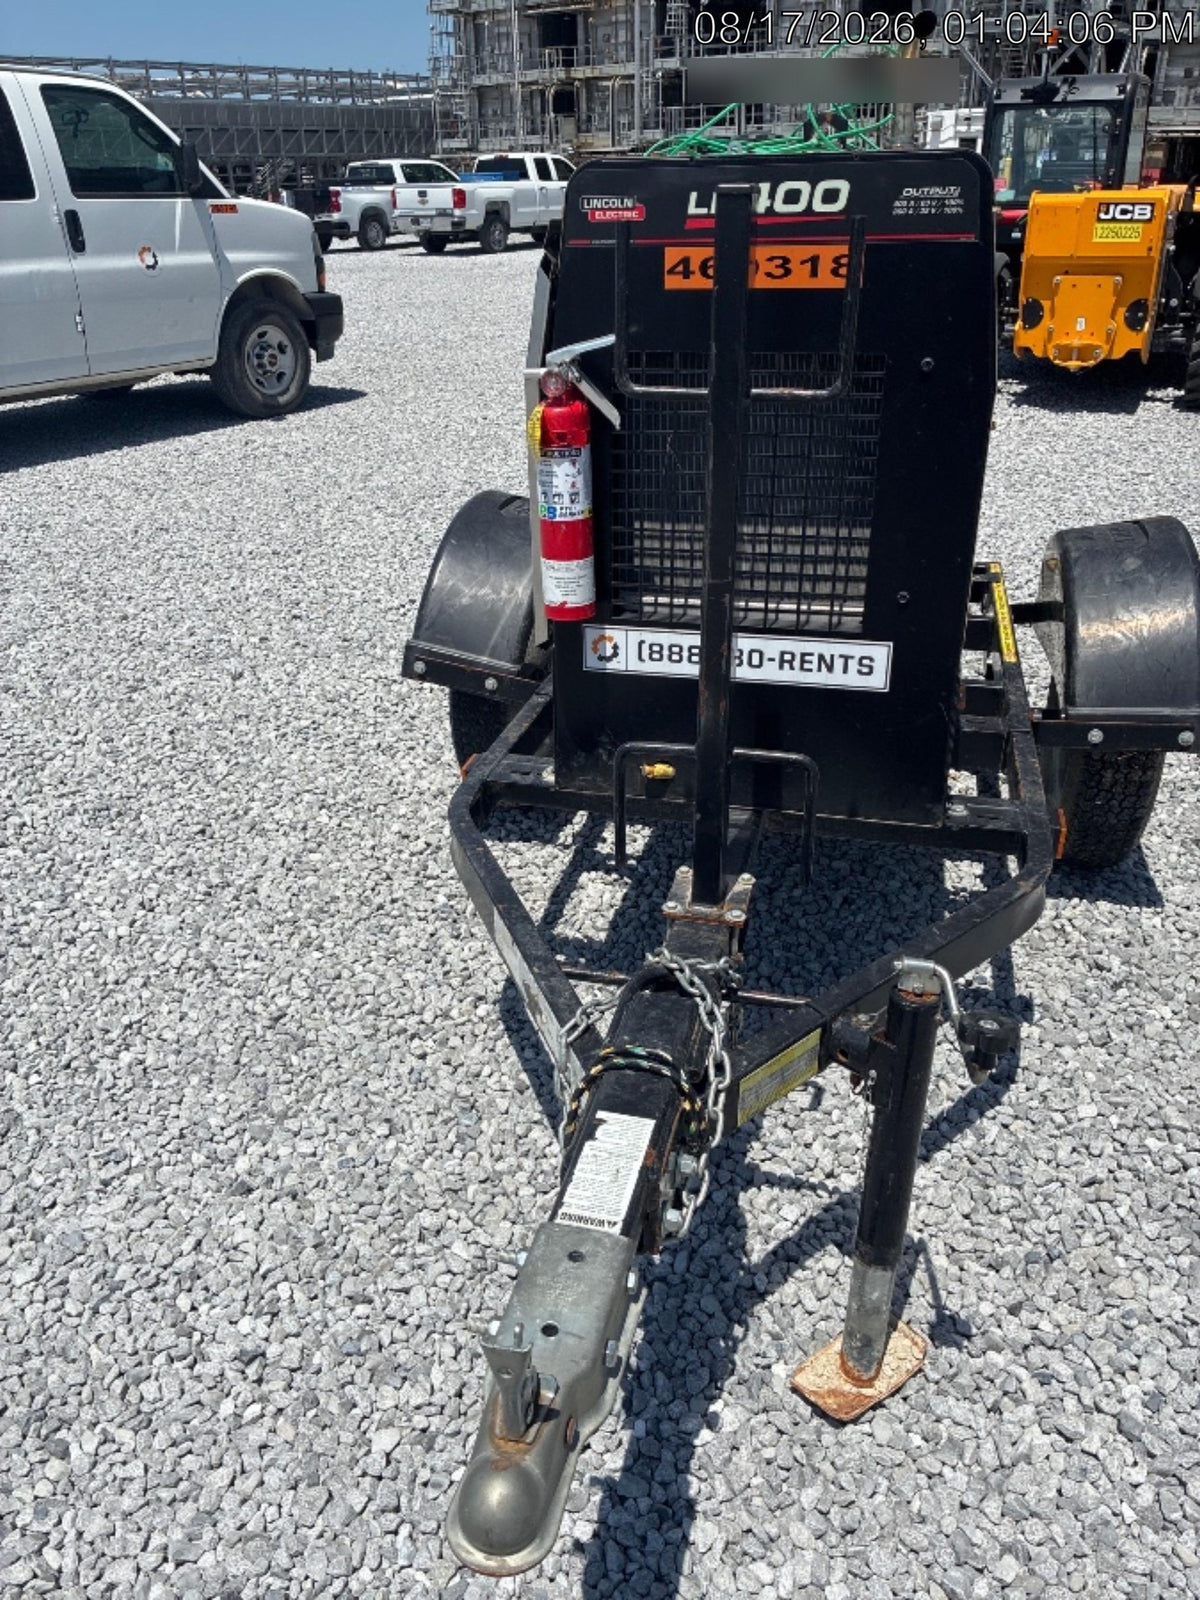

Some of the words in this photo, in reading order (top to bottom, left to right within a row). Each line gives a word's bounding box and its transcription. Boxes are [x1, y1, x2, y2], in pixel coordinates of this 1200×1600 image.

[902, 186, 958, 197] OUTPUT
[583, 198, 634, 209] LINCOLN
[594, 210, 640, 220] ELECTRIC
[1098, 203, 1152, 220] JCB
[560, 1212, 605, 1228] WARNING
